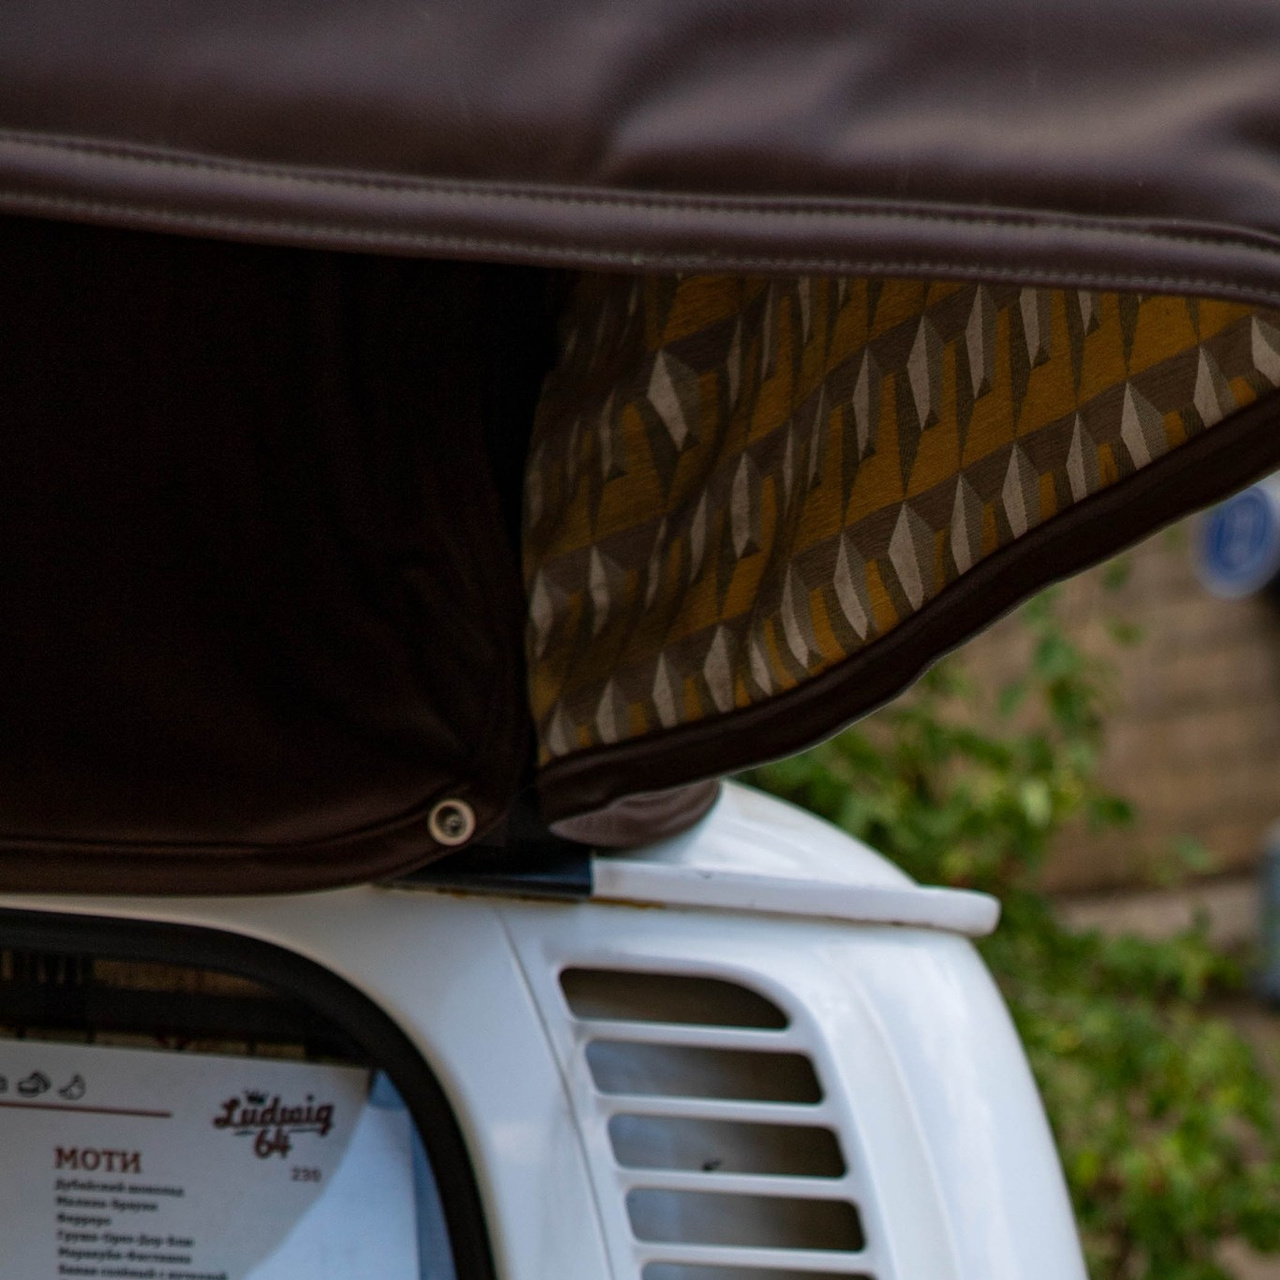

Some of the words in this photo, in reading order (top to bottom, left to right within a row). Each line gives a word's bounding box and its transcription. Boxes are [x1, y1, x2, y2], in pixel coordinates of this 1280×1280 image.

[213, 1096, 334, 1136] Ludwig
[54, 1145, 142, 1174] МОТИ
[254, 1131, 291, 1160] 64
